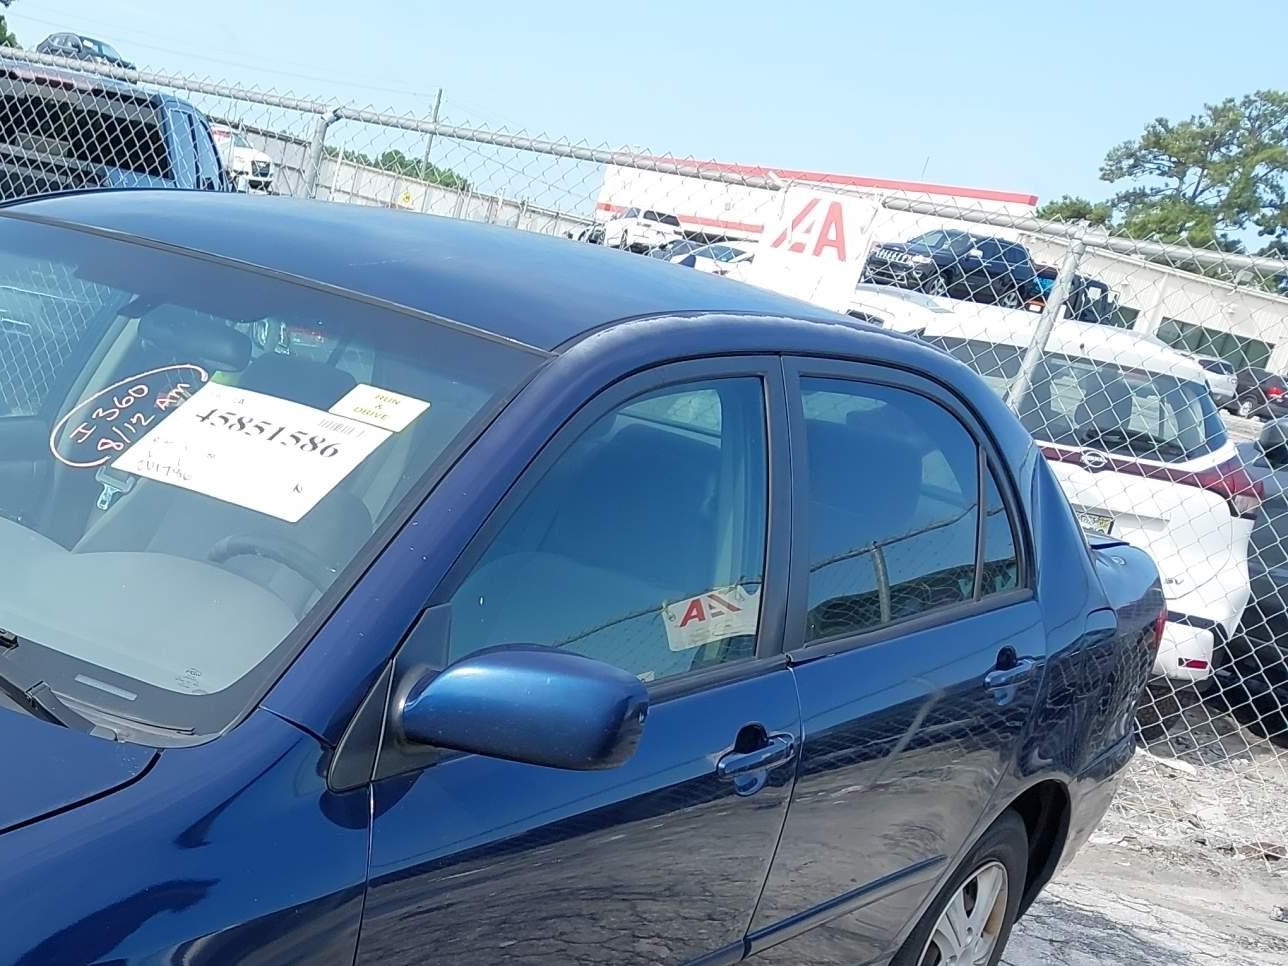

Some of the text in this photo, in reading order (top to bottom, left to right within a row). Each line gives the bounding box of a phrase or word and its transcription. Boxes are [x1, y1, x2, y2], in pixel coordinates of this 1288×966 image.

[92, 385, 149, 420] 360
[353, 406, 388, 420] DRIVE
[374, 394, 400, 405] RUN
[97, 413, 156, 450] 8/12
[196, 408, 341, 457] 45851586
